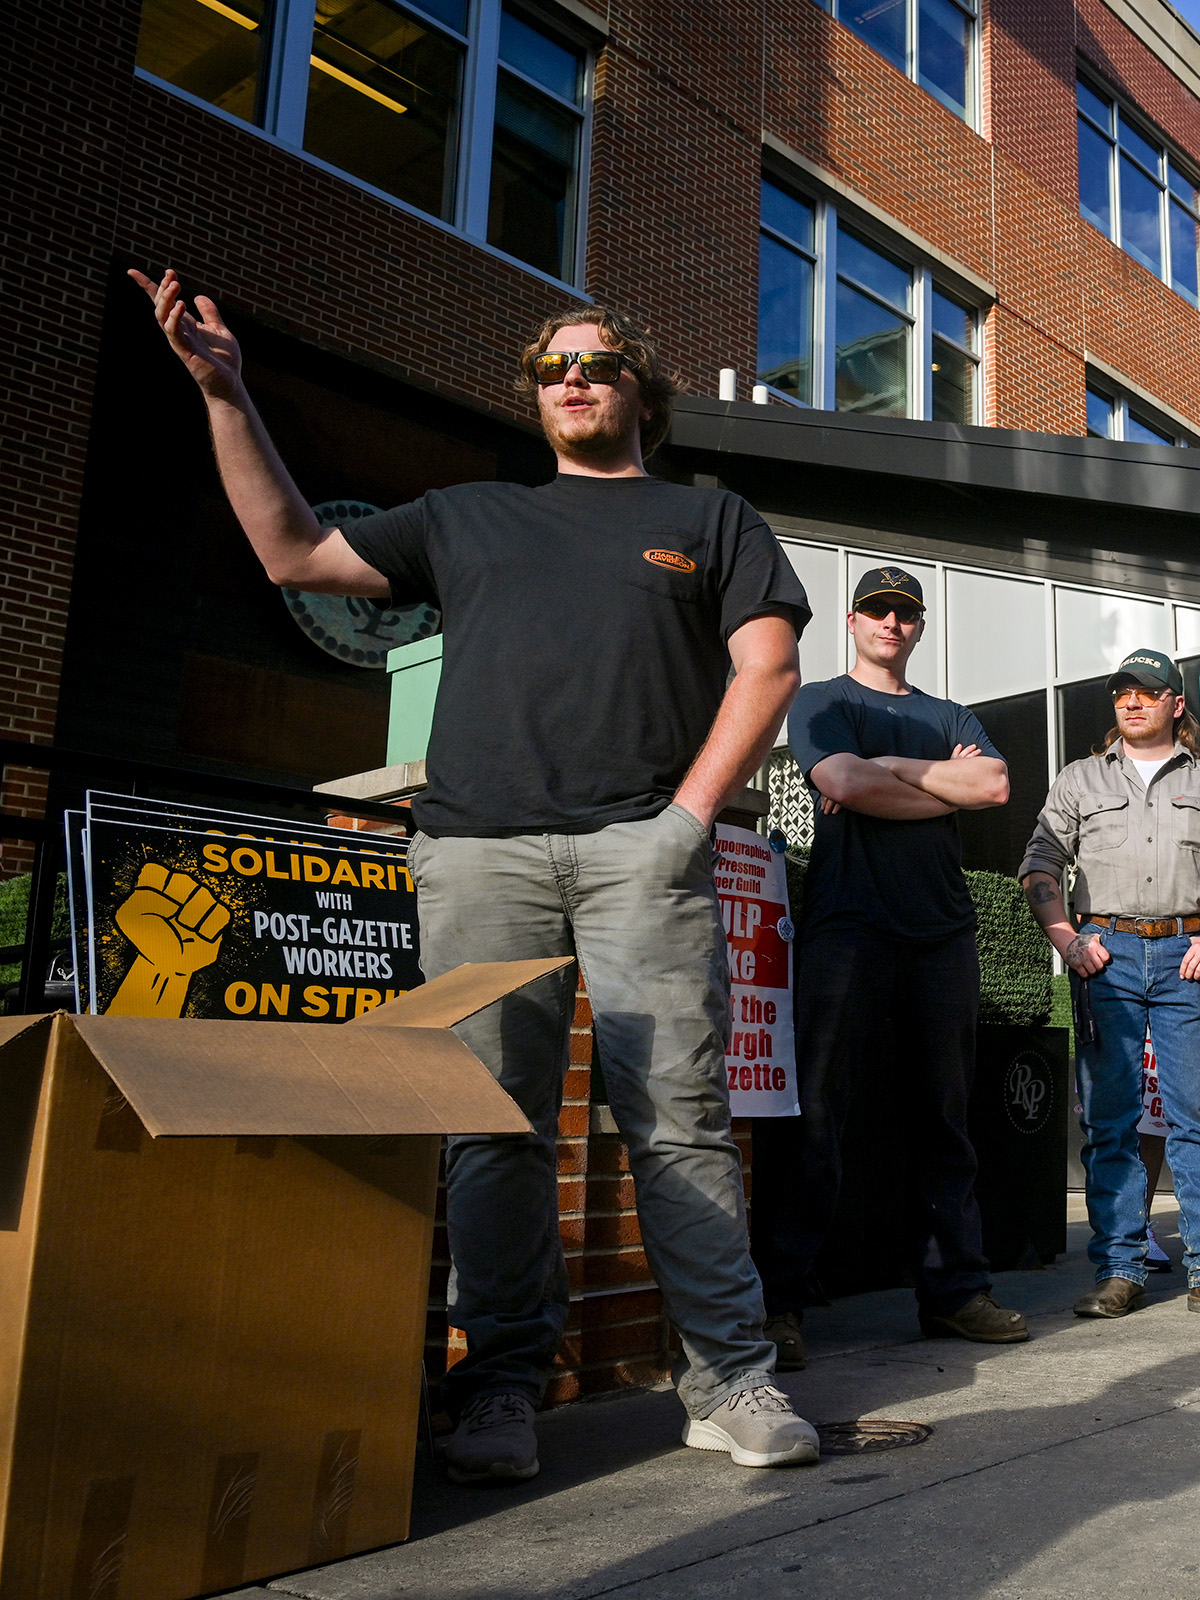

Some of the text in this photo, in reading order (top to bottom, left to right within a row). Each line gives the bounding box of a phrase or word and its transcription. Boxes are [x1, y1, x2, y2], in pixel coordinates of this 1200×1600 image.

[202, 843, 415, 893] SOLIDARIT
[718, 857, 766, 879] Pressman
[315, 891, 353, 910] WITH
[736, 877, 761, 894] Guild
[254, 910, 414, 949] POST-GAZETTE
[282, 946, 393, 979] WORKERS
[224, 981, 408, 1018] ON STR
[741, 995, 777, 1025] the
